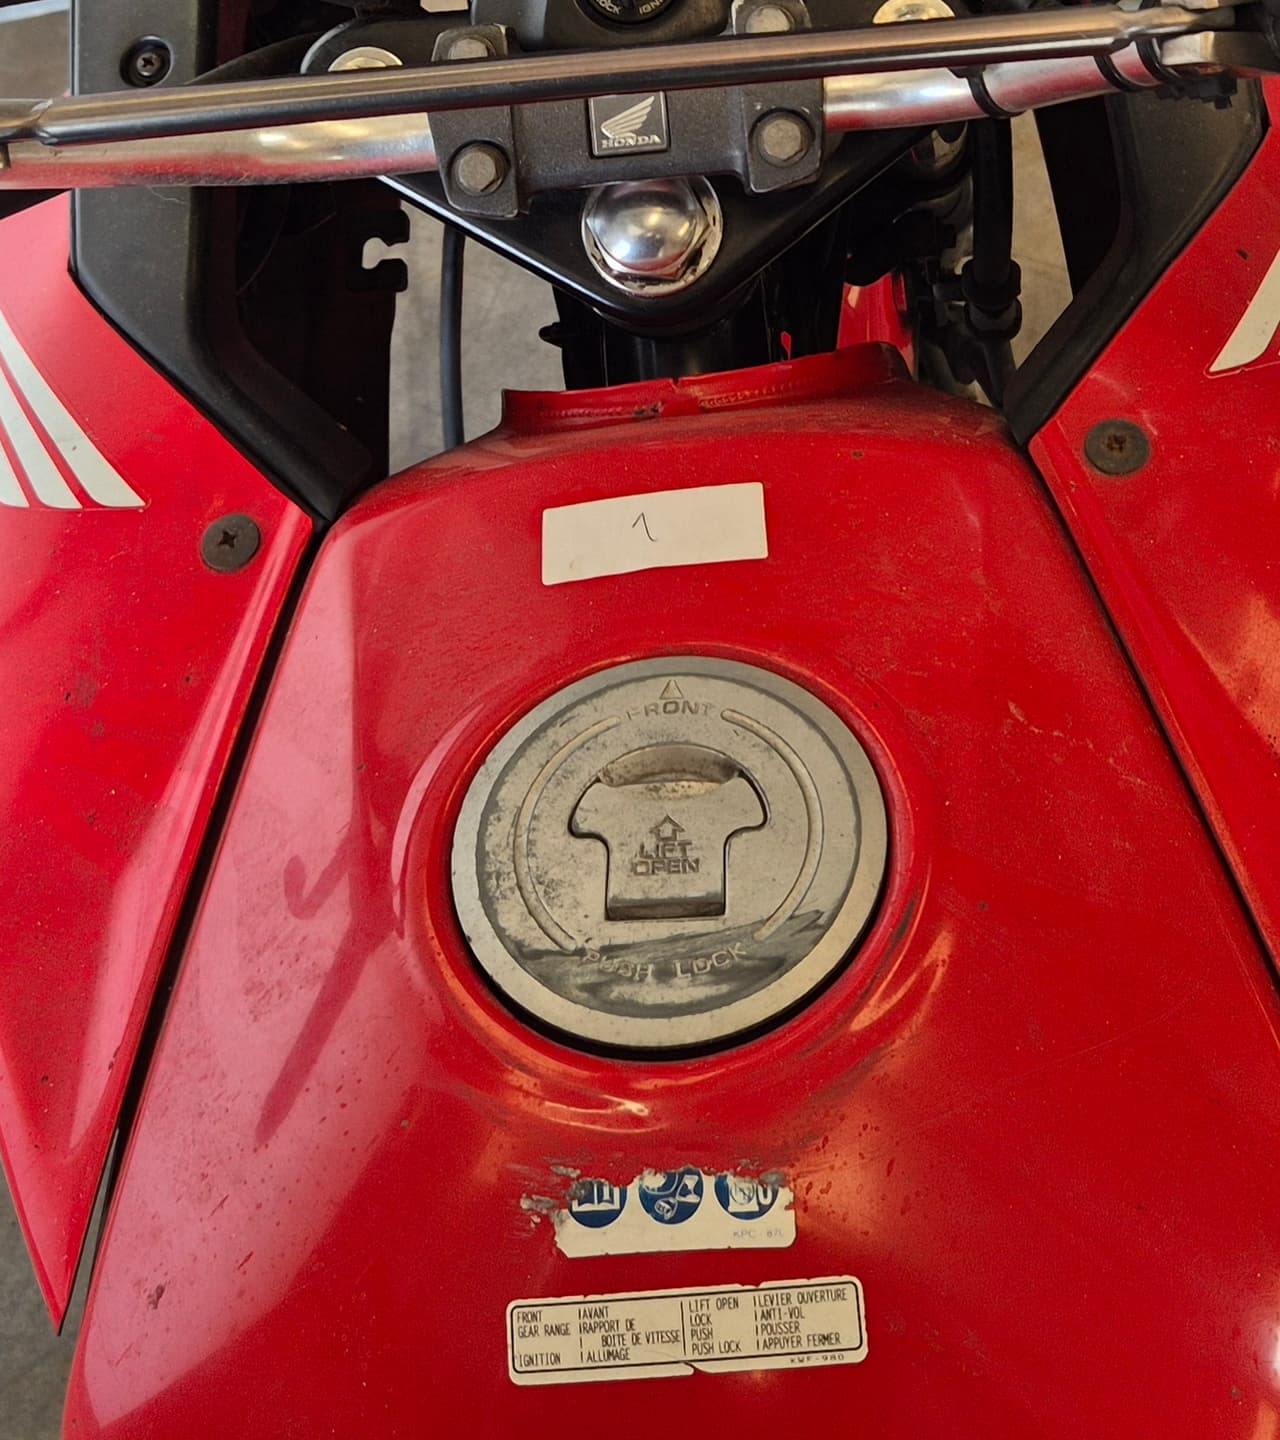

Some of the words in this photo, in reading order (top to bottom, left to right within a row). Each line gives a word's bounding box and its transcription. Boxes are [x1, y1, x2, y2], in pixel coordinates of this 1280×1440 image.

[602, 135, 661, 148] HONDA
[626, 700, 716, 720] FRONT
[638, 841, 692, 859] LIFT
[631, 858, 700, 875] OPEN
[675, 942, 746, 979] LOCK
[689, 1299, 710, 1313] LIFT
[716, 1297, 739, 1310] OPEN
[758, 1292, 792, 1307] LEVIER
[797, 1288, 848, 1304] OUVERTURE
[517, 1311, 543, 1324] FRONT
[582, 1306, 609, 1320] AVANT
[690, 1314, 712, 1327] LOCK
[518, 1325, 539, 1339] GEAR
[544, 1323, 570, 1336] RANGE
[582, 1320, 620, 1334] RAPPORT
[625, 1319, 636, 1332] DE
[761, 1322, 801, 1336] POUSSER
[601, 1334, 626, 1348] BOITE
[631, 1332, 642, 1345] DE
[645, 1330, 681, 1344] VITESSE
[691, 1328, 713, 1341] PUSH
[762, 1335, 802, 1350] APPUYER
[807, 1332, 841, 1347] FERMER
[586, 1348, 630, 1361] ALLUMAGE
[692, 1342, 714, 1355] PUSH
[720, 1340, 742, 1353] LOCK
[520, 1353, 561, 1368] IGNITION
